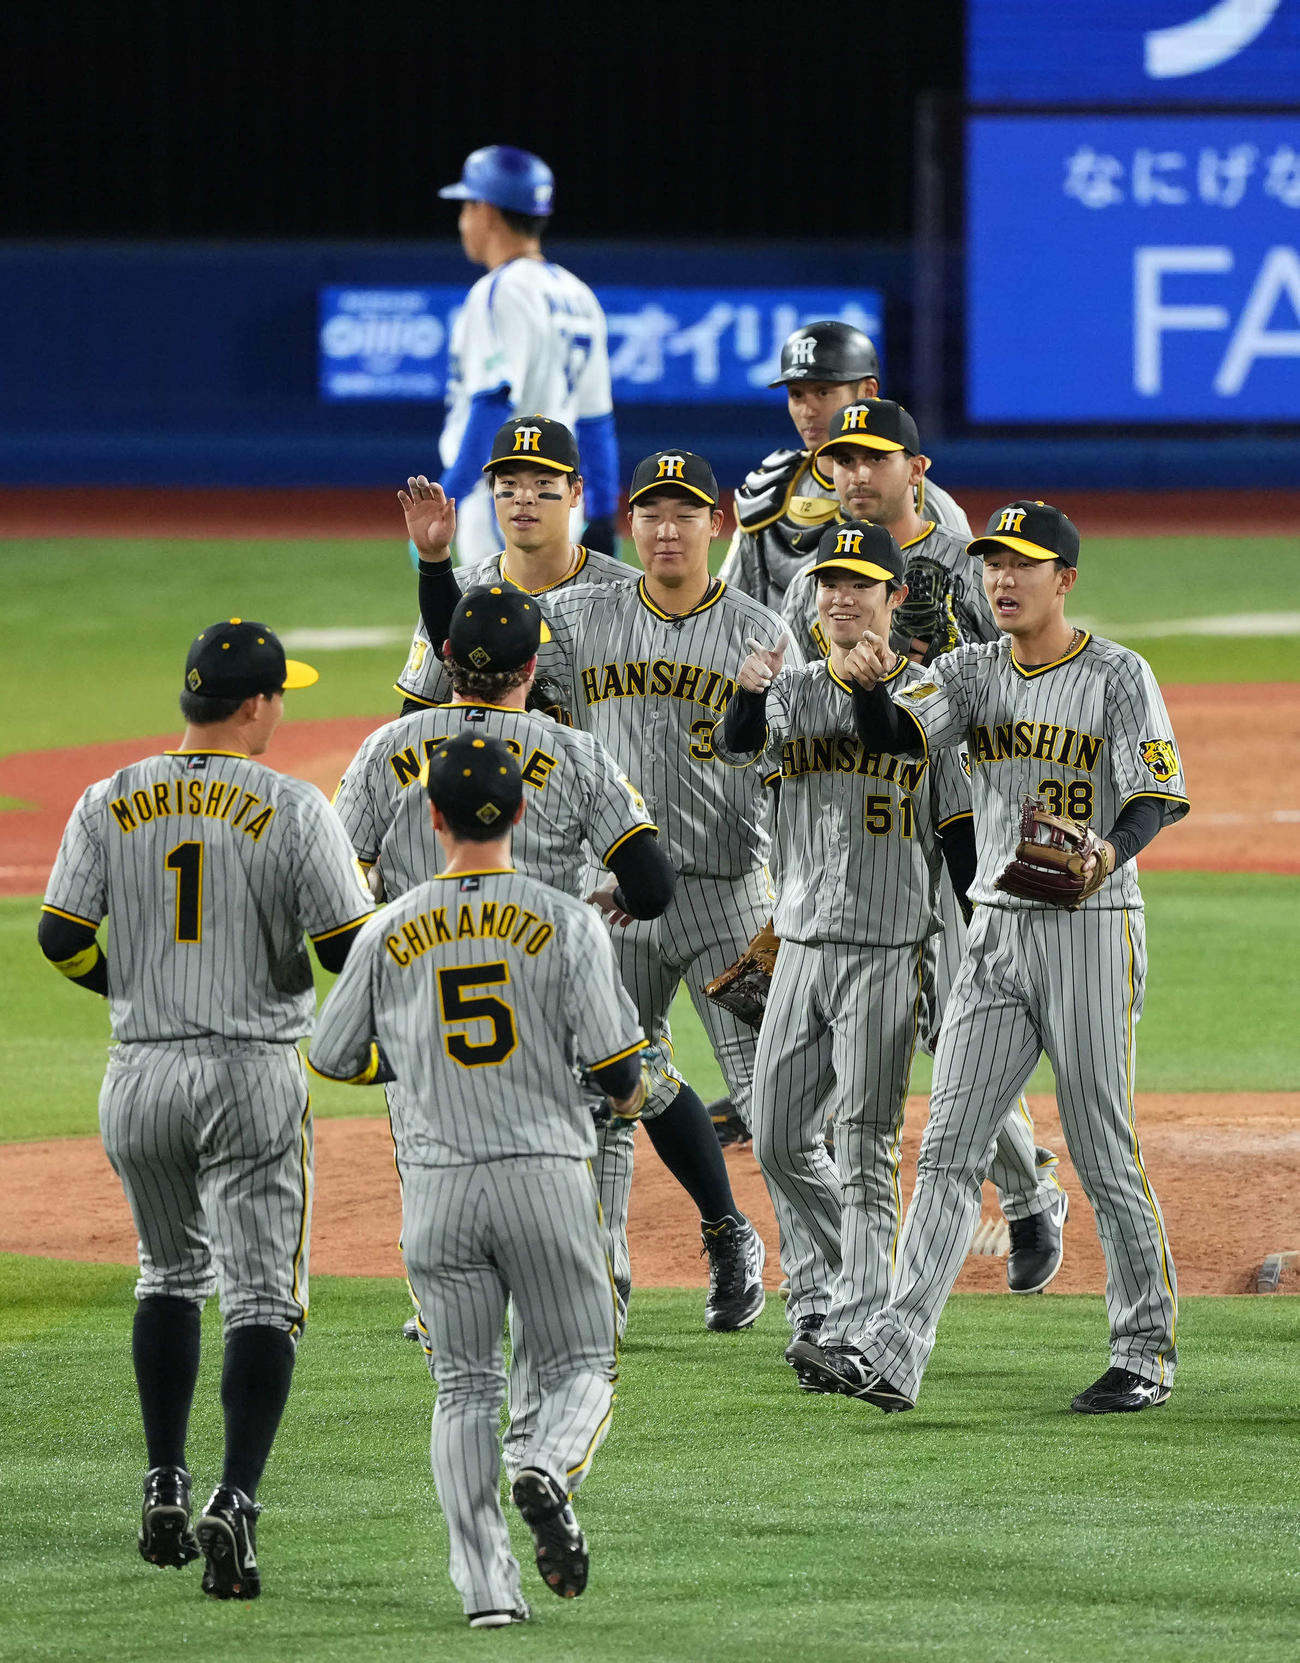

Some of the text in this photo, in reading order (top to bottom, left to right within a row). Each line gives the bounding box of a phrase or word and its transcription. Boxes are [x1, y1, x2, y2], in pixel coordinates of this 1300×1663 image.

[606, 301, 880, 390] オイリ
[1133, 245, 1300, 397] FA
[581, 658, 740, 714] HANSHIN
[780, 735, 929, 792] HANSHIN
[974, 719, 1105, 773] ANSHIN
[109, 779, 275, 842] MORISHITA
[864, 794, 913, 839] 51
[1038, 779, 1095, 822] 38
[164, 840, 204, 943] 1
[385, 901, 556, 968] CHIKAMOTO
[436, 959, 519, 1069] 5
